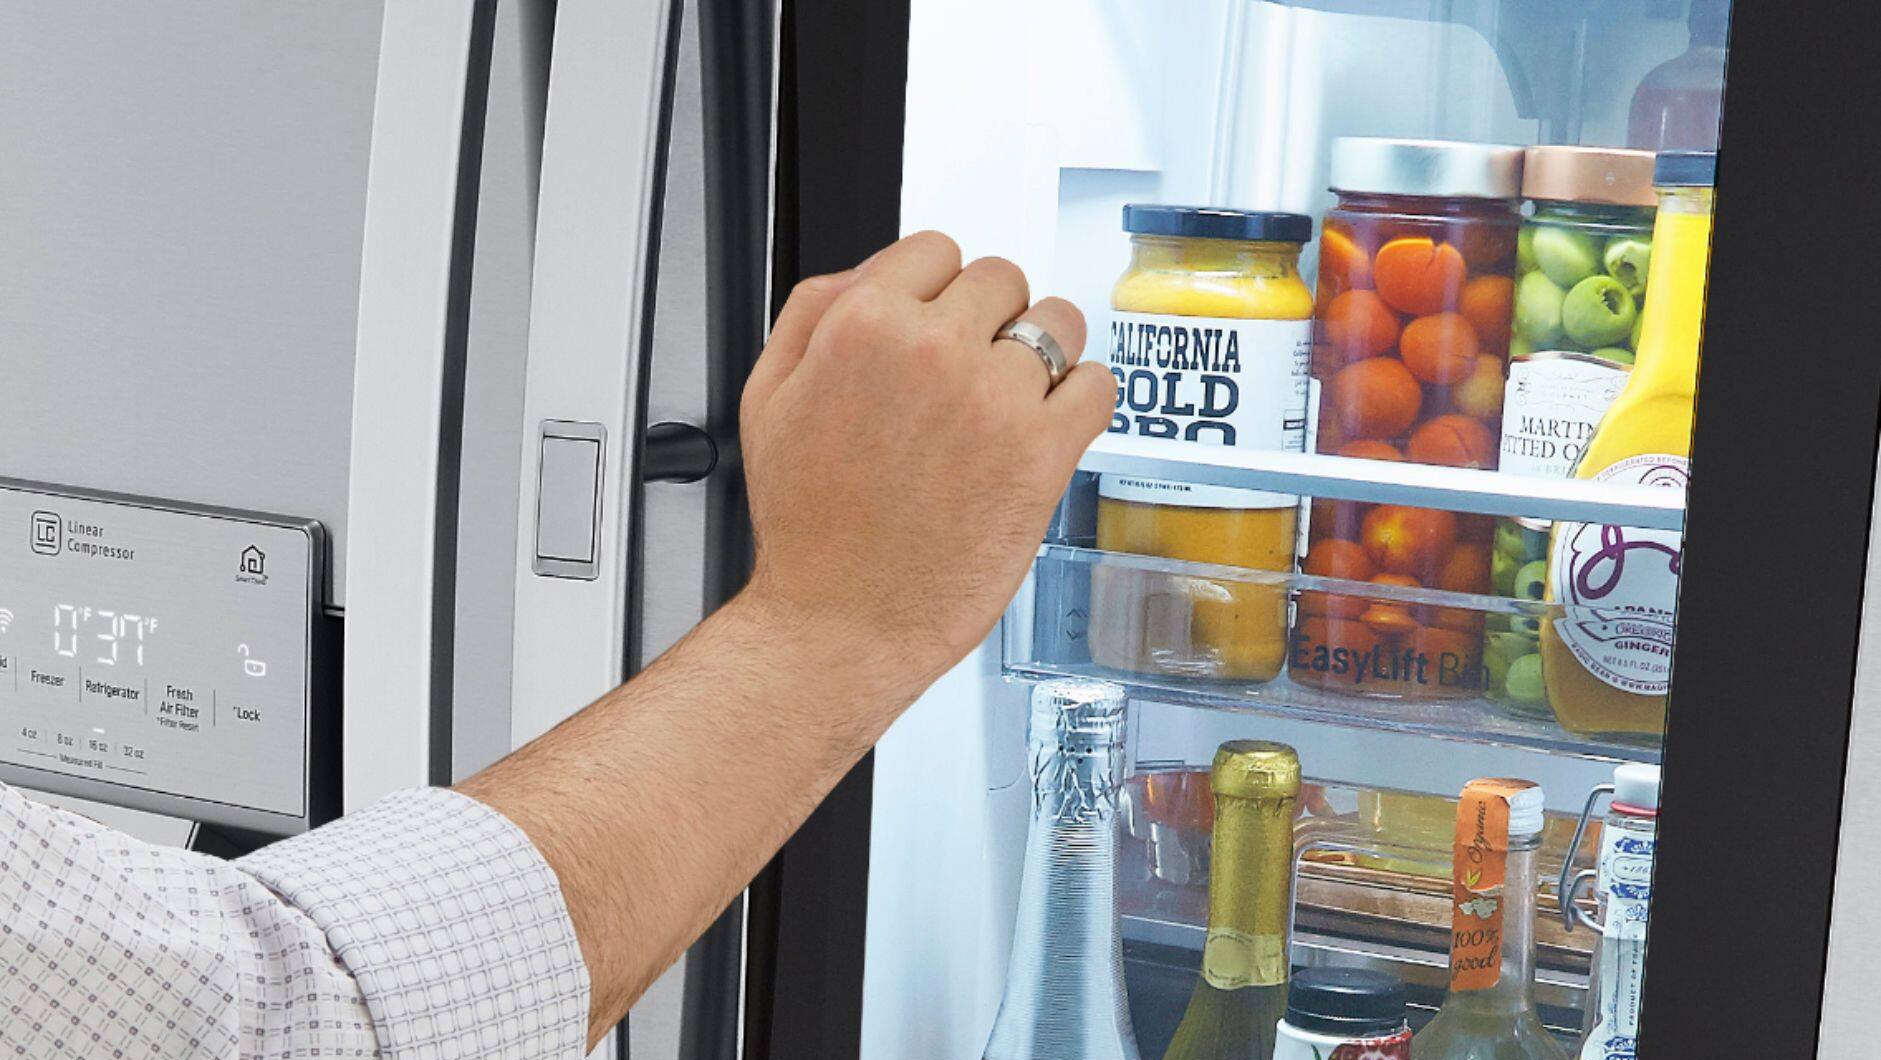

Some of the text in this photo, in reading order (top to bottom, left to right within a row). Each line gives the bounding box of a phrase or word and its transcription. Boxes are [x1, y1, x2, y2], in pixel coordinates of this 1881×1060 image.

[1110, 320, 1241, 373] CALIFORNIA
[1110, 366, 1240, 418] GOLD
[68, 519, 104, 538] Linear
[67, 538, 135, 561] Compressor
[1614, 640, 1670, 656] GINGER
[1289, 630, 1490, 692] EasyLift Bin
[31, 669, 65, 687] Freezer
[85, 679, 140, 700] Refrigerator
[166, 685, 193, 701] Fresh
[160, 701, 200, 719] Air Filter
[1453, 927, 1499, 950] 100%
[1454, 946, 1497, 981] good
